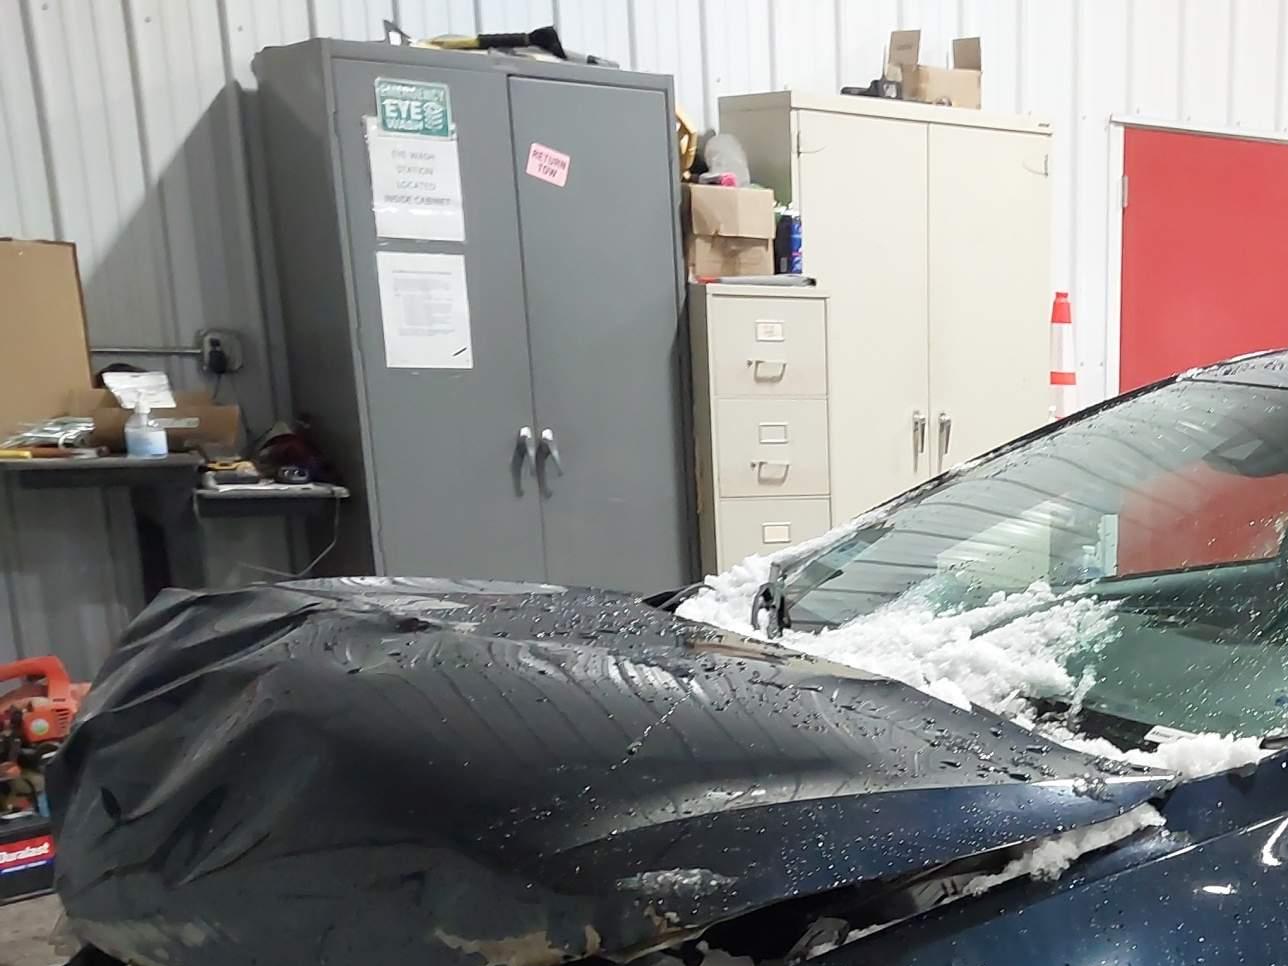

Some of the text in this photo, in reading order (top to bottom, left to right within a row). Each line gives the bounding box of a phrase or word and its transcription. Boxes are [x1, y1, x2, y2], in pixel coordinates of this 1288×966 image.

[382, 99, 423, 120] EYE
[532, 150, 567, 170] RETURN
[538, 163, 558, 178] TOW
